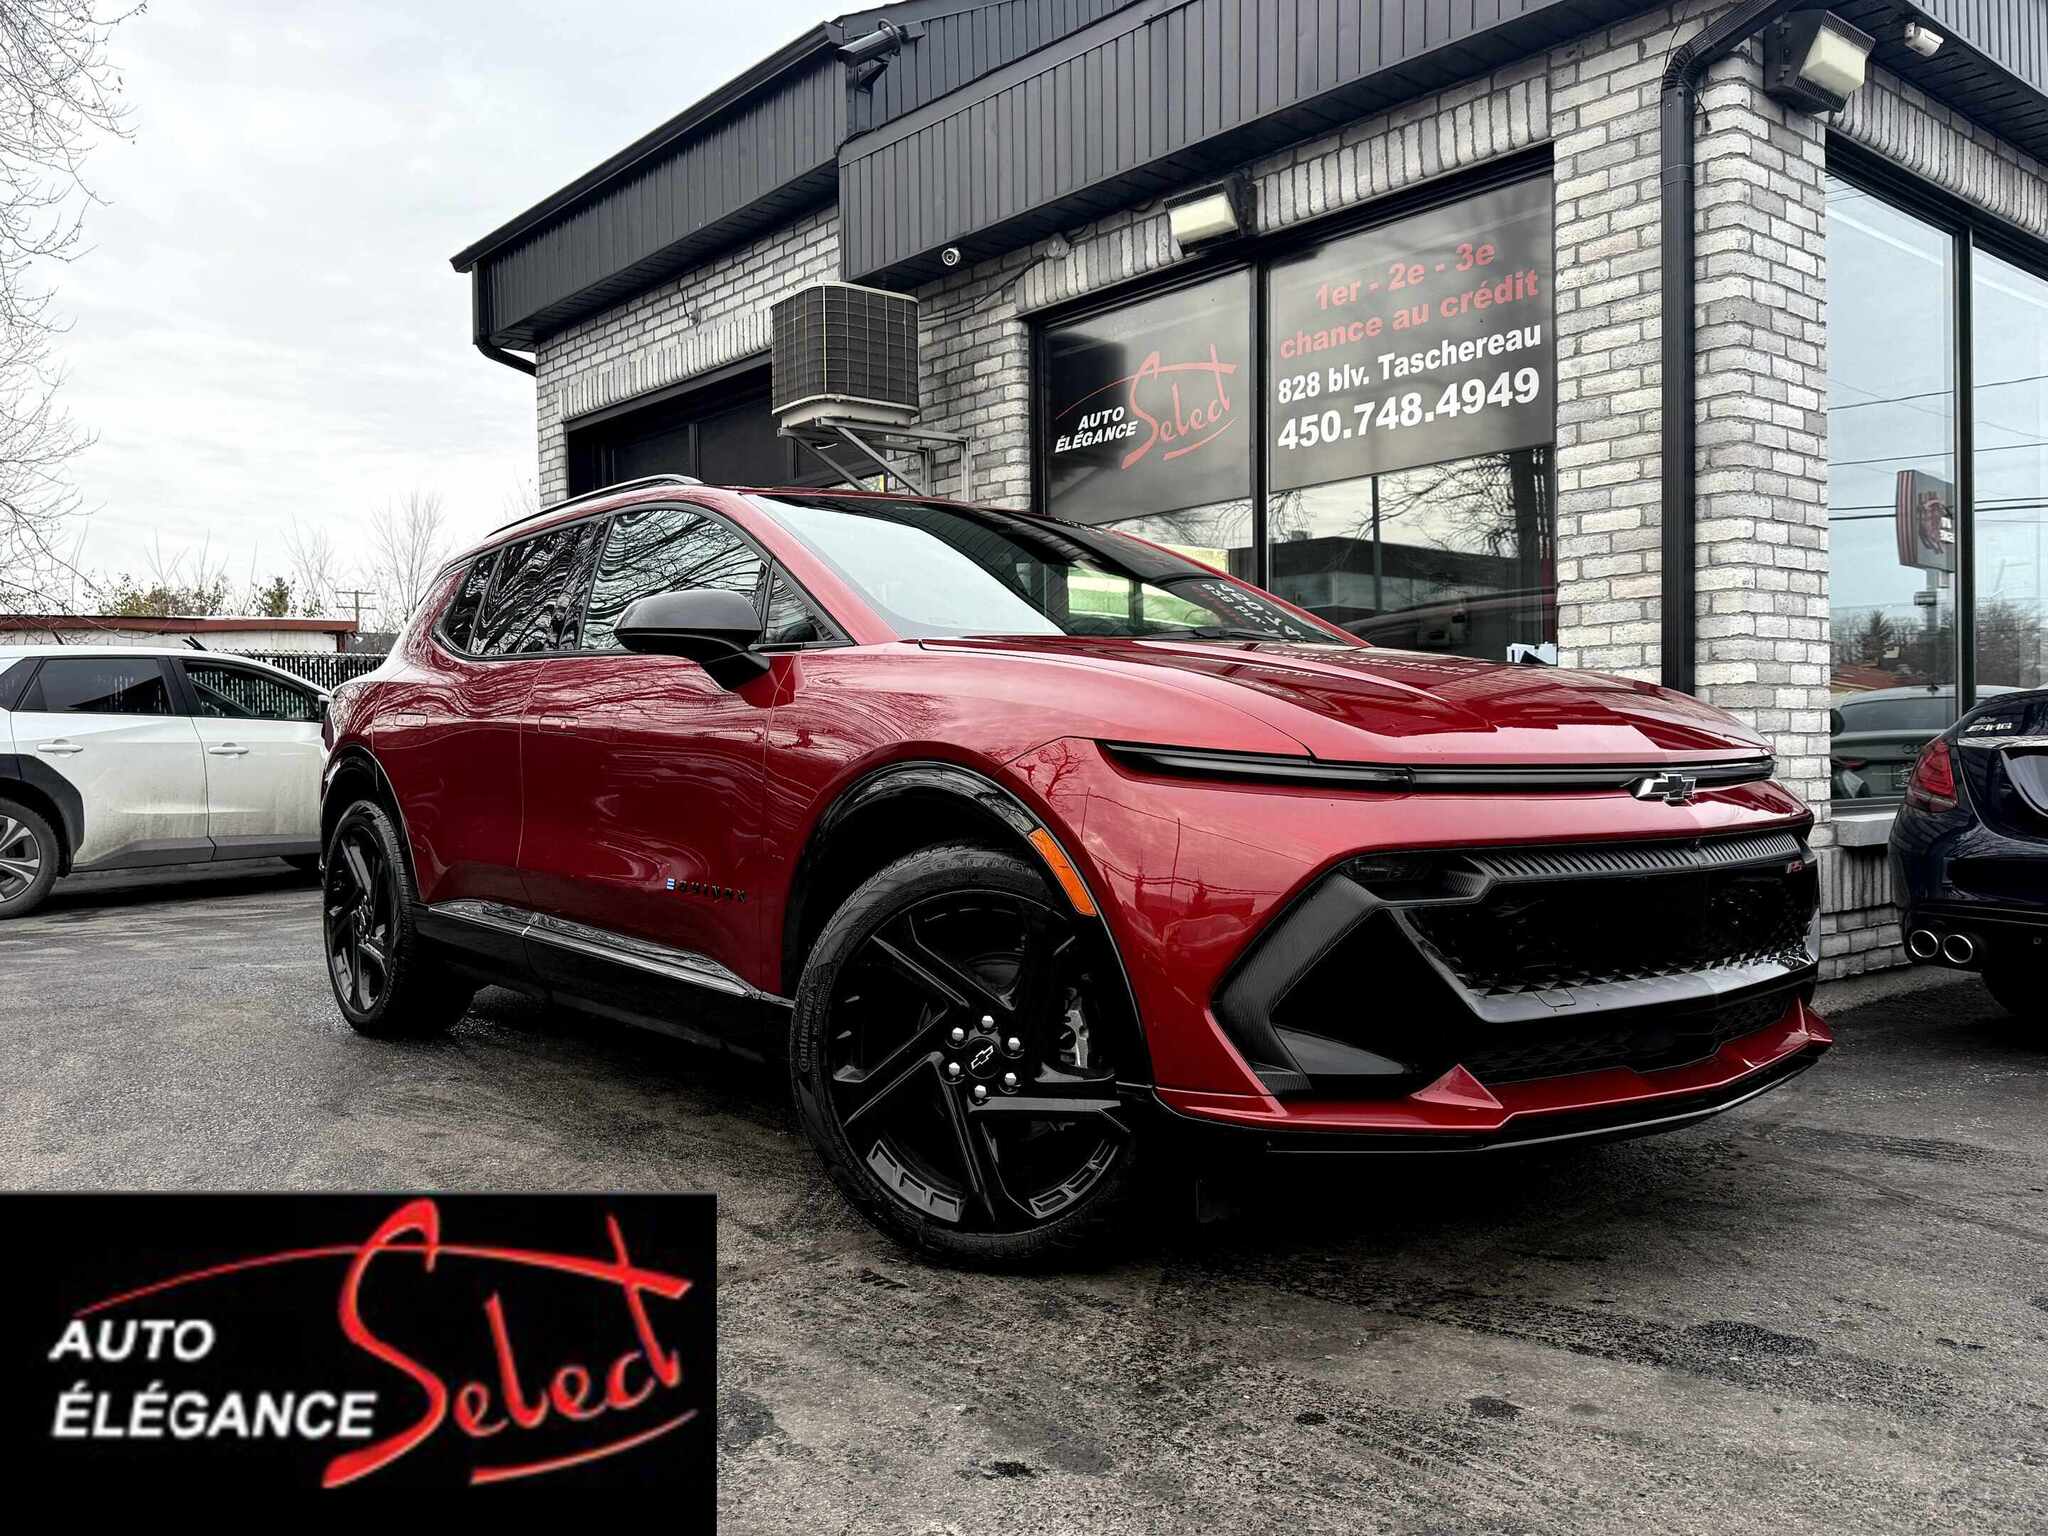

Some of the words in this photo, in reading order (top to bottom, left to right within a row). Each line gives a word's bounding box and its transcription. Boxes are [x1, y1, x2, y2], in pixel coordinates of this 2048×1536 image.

[1316, 279, 1361, 312] 1er
[1388, 261, 1426, 292] 2e
[1455, 241, 1496, 273] 3e
[1279, 316, 1384, 360] chance
[1391, 301, 1430, 332] au
[1440, 269, 1539, 319] crédit
[1277, 370, 1321, 404] 828
[1328, 362, 1371, 394] blv.
[1377, 324, 1542, 381] Taschereau
[1054, 419, 1138, 454] ÉLÉGANCE
[1077, 405, 1126, 431] AUTO
[1277, 367, 1541, 450] 450.748.4949
